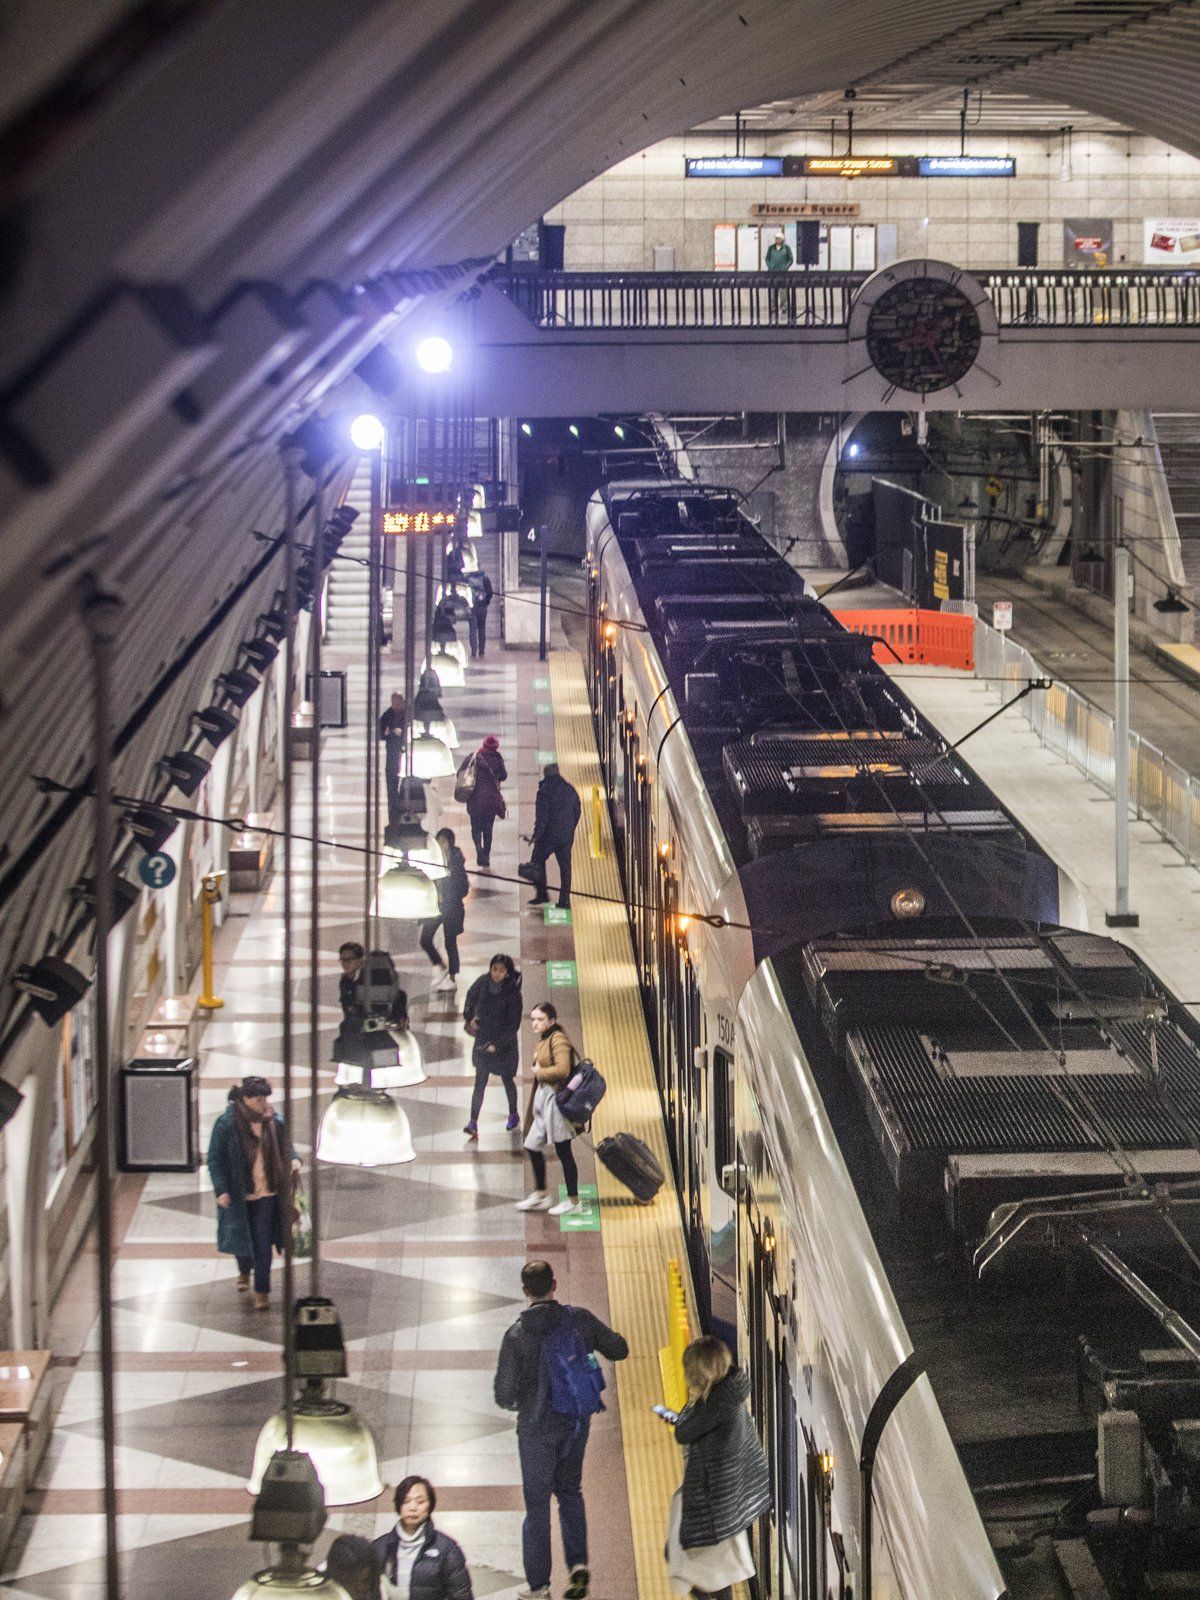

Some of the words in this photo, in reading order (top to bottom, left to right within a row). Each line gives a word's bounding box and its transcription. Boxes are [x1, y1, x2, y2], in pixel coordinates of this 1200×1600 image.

[758, 203, 805, 213] Pioneer
[811, 203, 855, 215] Square
[527, 527, 536, 542] 4
[717, 1013, 735, 1047] 150A
